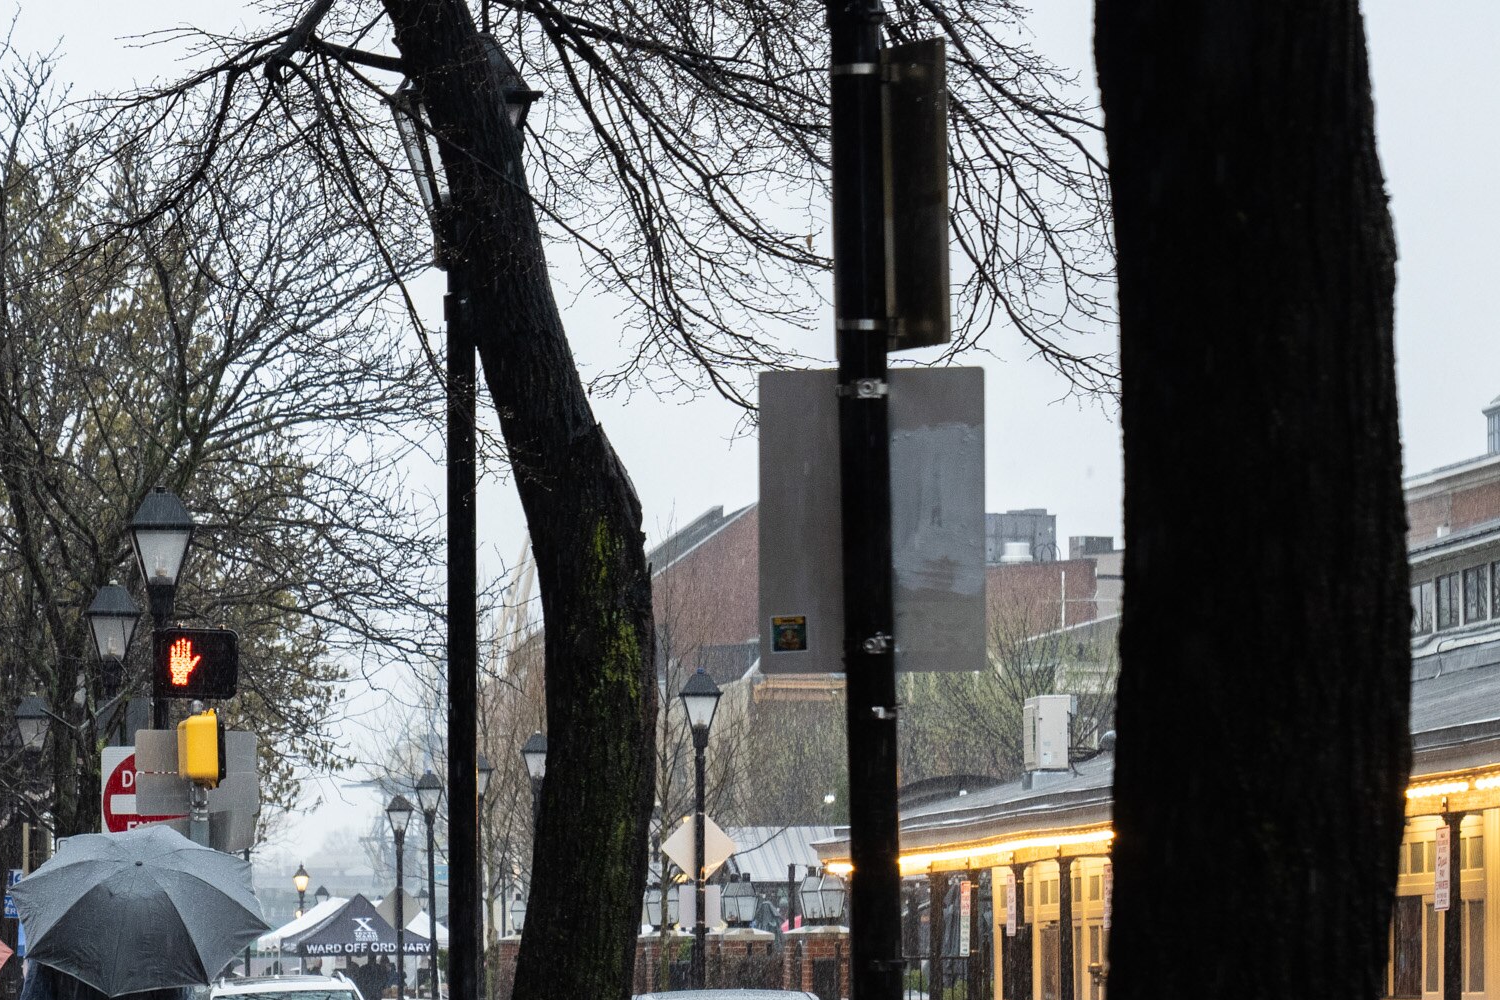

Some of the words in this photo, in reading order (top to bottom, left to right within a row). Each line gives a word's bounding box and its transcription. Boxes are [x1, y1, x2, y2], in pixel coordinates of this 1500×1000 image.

[306, 943, 342, 954] WARD
[344, 942, 368, 953] OFF
[370, 942, 431, 953] ORDNARY
